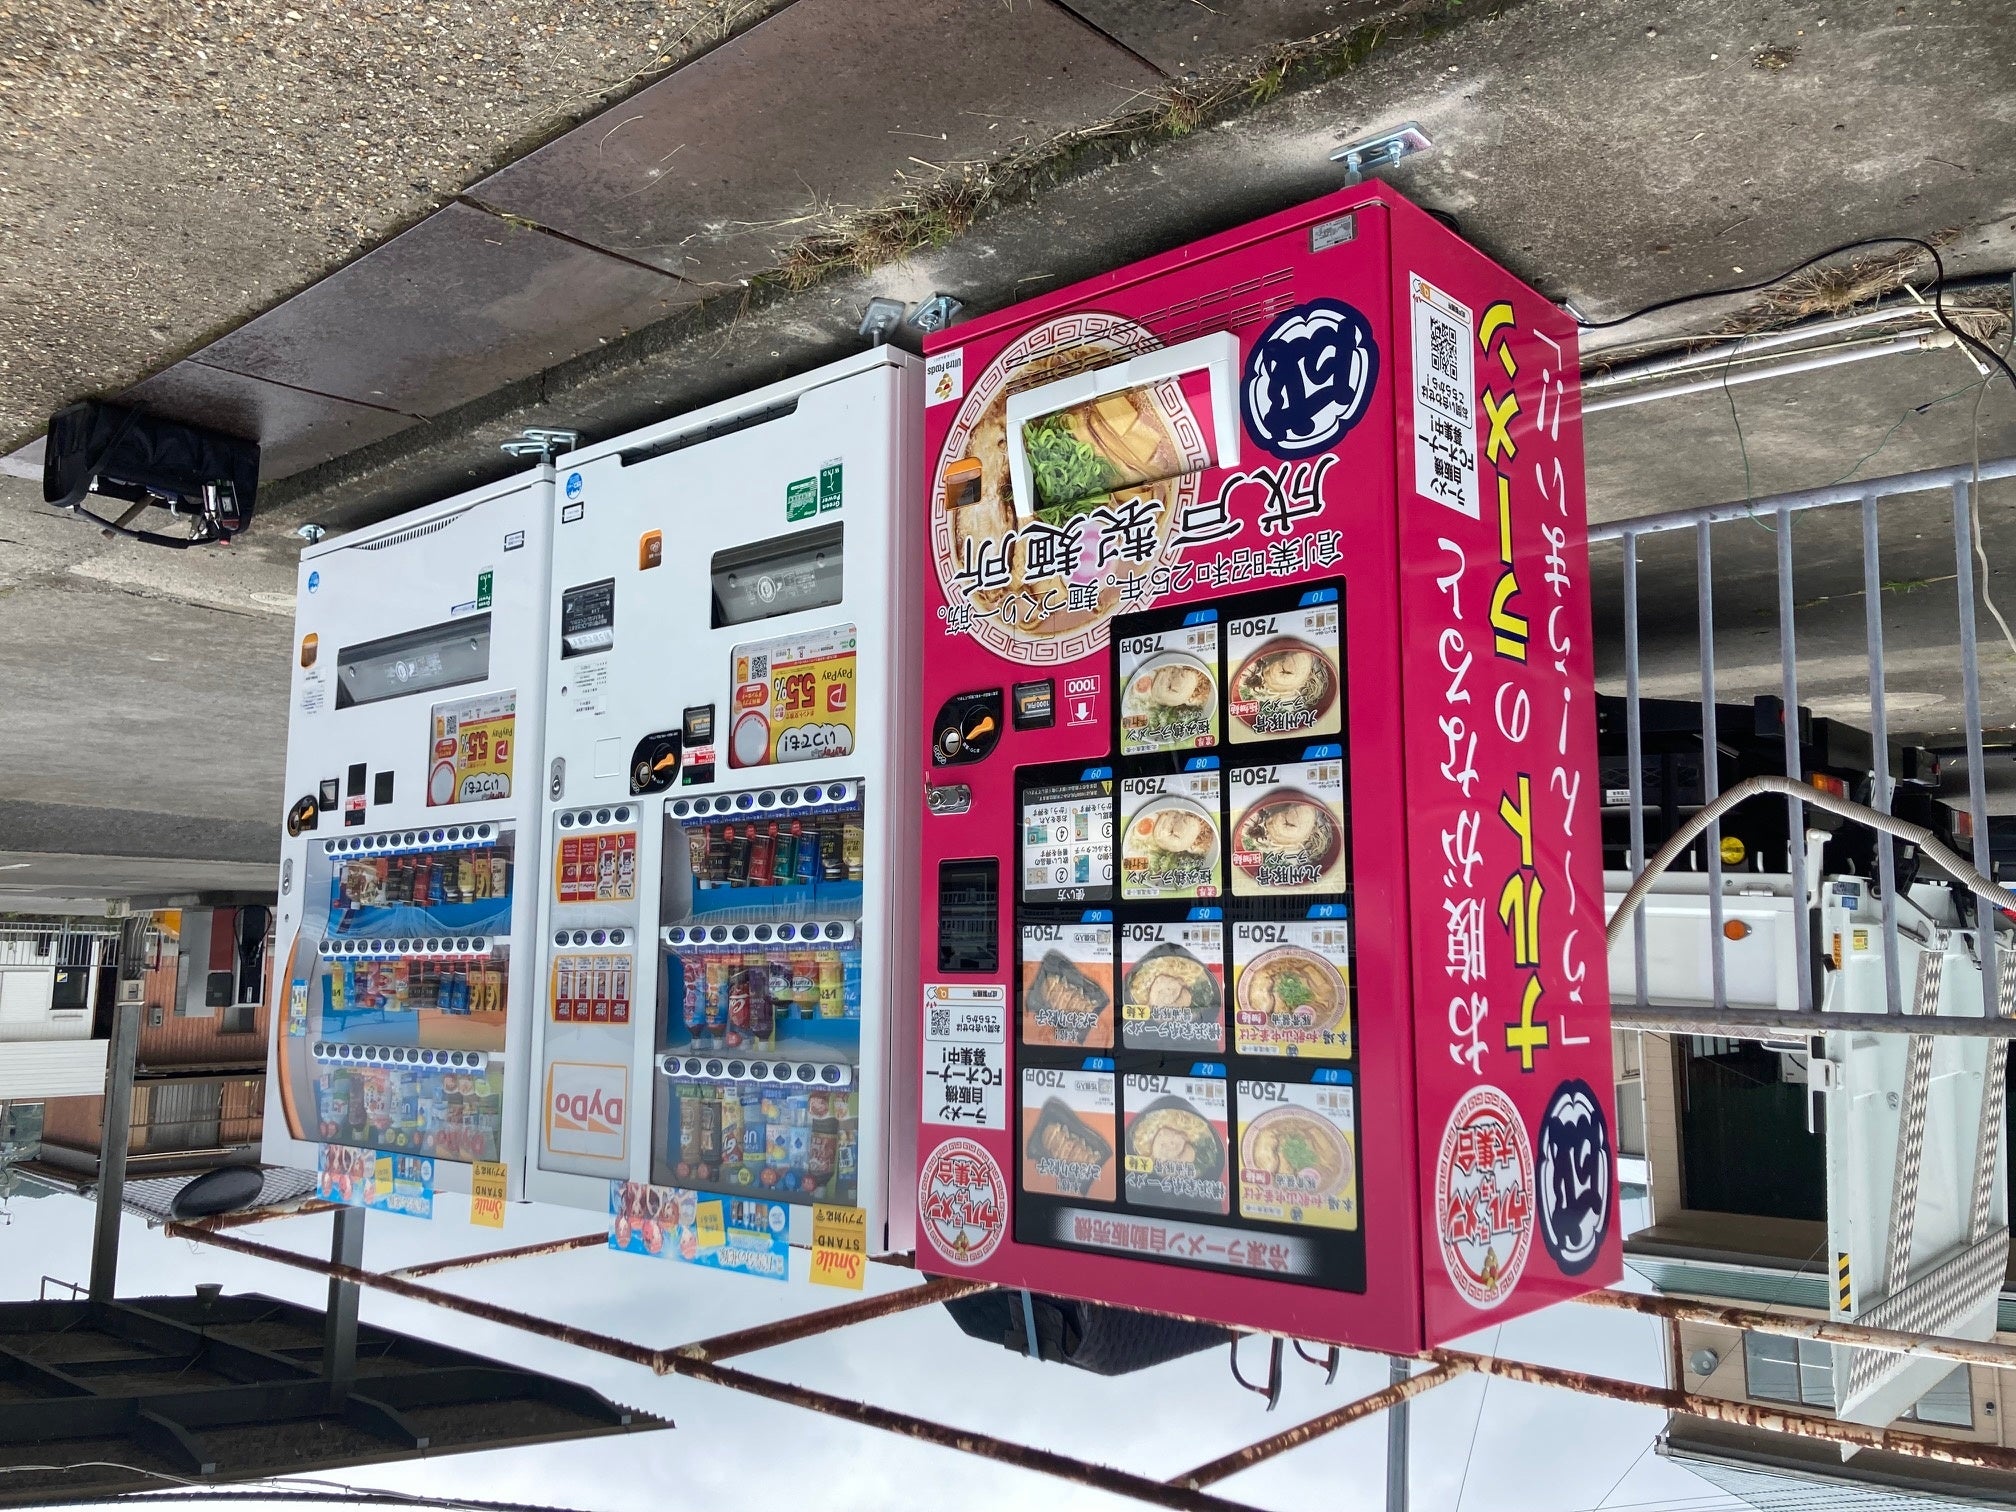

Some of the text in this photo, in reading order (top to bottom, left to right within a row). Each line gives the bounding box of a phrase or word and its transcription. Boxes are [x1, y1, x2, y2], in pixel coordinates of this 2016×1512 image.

[927, 362, 945, 375] Foods
[945, 357, 961, 369] Ultra
[1248, 311, 1365, 452] 成
[1426, 373, 1465, 405] こちらから!
[1420, 385, 1469, 420] お問い合わせは
[1429, 414, 1463, 447] 募集中!
[822, 467, 840, 477] WIND
[1433, 455, 1462, 485] 自販機
[821, 493, 840, 503] Power
[1430, 477, 1465, 507] ラーメン
[821, 500, 840, 510] Green
[952, 452, 1340, 598] 成戸製麺所
[1312, 591, 1324, 603] 10
[1195, 611, 1205, 622] 11
[1230, 617, 1278, 638] 750円
[1121, 634, 1164, 655] 750円
[821, 667, 852, 681] PayPay
[773, 672, 816, 710] 5.5%
[1068, 678, 1095, 692] 1000
[1261, 696, 1304, 712] ラーメン
[785, 710, 814, 719] ポイント交換で
[1252, 709, 1317, 733] 九州豚骨
[491, 727, 513, 737] PayPay
[1125, 719, 1210, 741] 極み鶏ラーメン
[460, 730, 488, 761] 5.5%
[784, 731, 836, 752] いつでも!
[1195, 735, 1213, 747] 濃厚
[1315, 745, 1328, 757] 07
[1195, 757, 1207, 769] 08
[1090, 768, 1102, 780] 09
[1230, 766, 1280, 786] 750円
[464, 779, 499, 795] いつでも!
[1124, 777, 1167, 795] 750円
[1031, 806, 1068, 817] 「かう」を押す
[1436, 536, 1490, 1075] お腹がなると
[1039, 814, 1068, 824] お金を入れ
[1033, 855, 1069, 866] 欲しい商品の
[1039, 847, 1068, 858] 番号を押す
[1232, 851, 1308, 866] ラーメン 極細麺
[1126, 868, 1212, 885] 極み鶏ラーメン
[1256, 864, 1322, 886] 九州豚骨
[1056, 887, 1085, 901] 使い方
[1090, 910, 1102, 922] 06
[1198, 908, 1210, 919] 05
[1319, 905, 1333, 917] 04
[1023, 924, 1063, 941] 750円
[1121, 924, 1165, 942] 750円
[1238, 924, 1288, 943] 750円
[960, 1013, 997, 1023] こちらから!
[1034, 1007, 1099, 1028] こだわり餃子
[1125, 1006, 1146, 1019] 太麺
[1271, 1013, 1312, 1027] 豚骨醤油
[955, 1022, 1001, 1033] お問い合わせは
[1123, 1021, 1222, 1041] 横浜家系ラーメン
[1238, 1028, 1347, 1046] 本場 和歌山中華そば
[941, 1046, 986, 1066] 募集中!
[1092, 1058, 1104, 1070] 03
[925, 1063, 1003, 1086] FCオーナー
[1024, 1068, 1066, 1089] 750円
[1201, 1063, 1214, 1076] 02
[1325, 1070, 1337, 1081] 01
[1125, 1073, 1171, 1094] 750円
[1238, 1080, 1289, 1102] 750円
[944, 1084, 983, 1105] 自販機
[555, 1088, 623, 1125] DyDo
[938, 1104, 987, 1124] ラーメン
[1455, 1124, 1514, 1174] 大集合
[935, 1157, 989, 1190] 大集合
[1036, 1157, 1101, 1181] こだわり餃子
[1125, 1172, 1226, 1201] 横浜家系ラーメン
[1545, 1100, 1606, 1258] 成
[475, 1185, 503, 1198] STAND
[475, 1196, 503, 1221] Smile
[826, 1211, 864, 1225] アプリ対応
[817, 1234, 860, 1251] STAND
[1073, 1216, 1289, 1272] 冷凍ラーメン自動販売機
[815, 1249, 860, 1279] Smile
